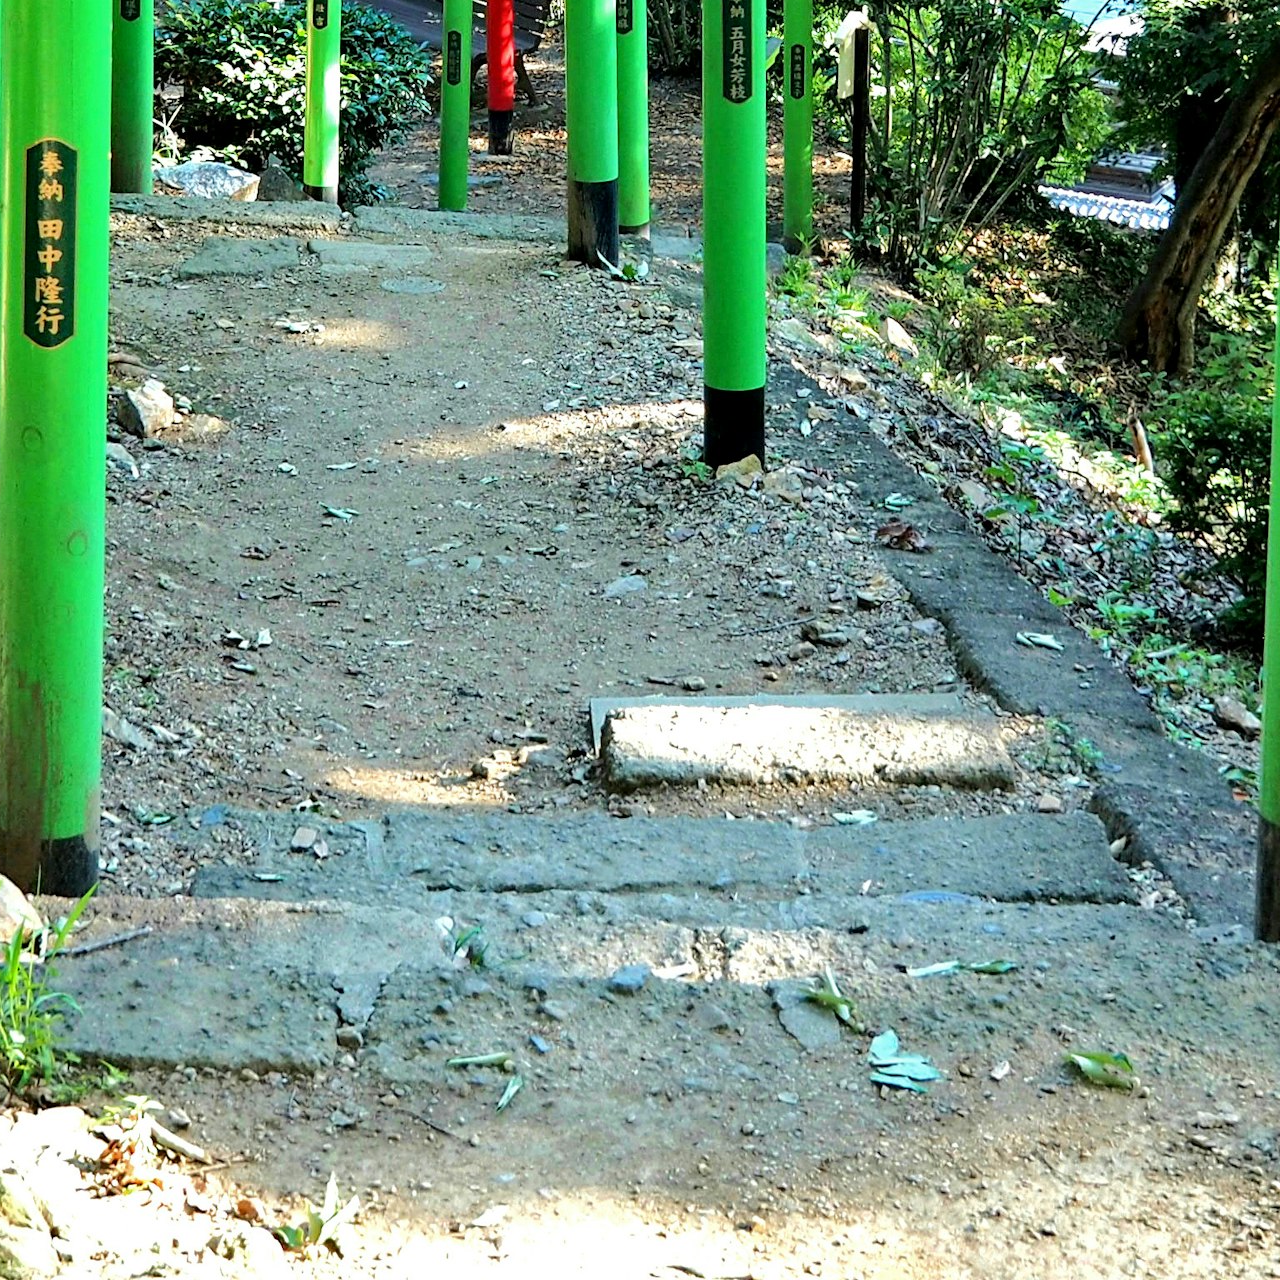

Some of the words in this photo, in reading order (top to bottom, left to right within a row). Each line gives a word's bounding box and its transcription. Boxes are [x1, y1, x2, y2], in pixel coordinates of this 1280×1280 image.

[729, 26, 747, 99] 五月女芳枝
[38, 151, 64, 202] 奉納
[34, 219, 64, 335] 田中隆行
